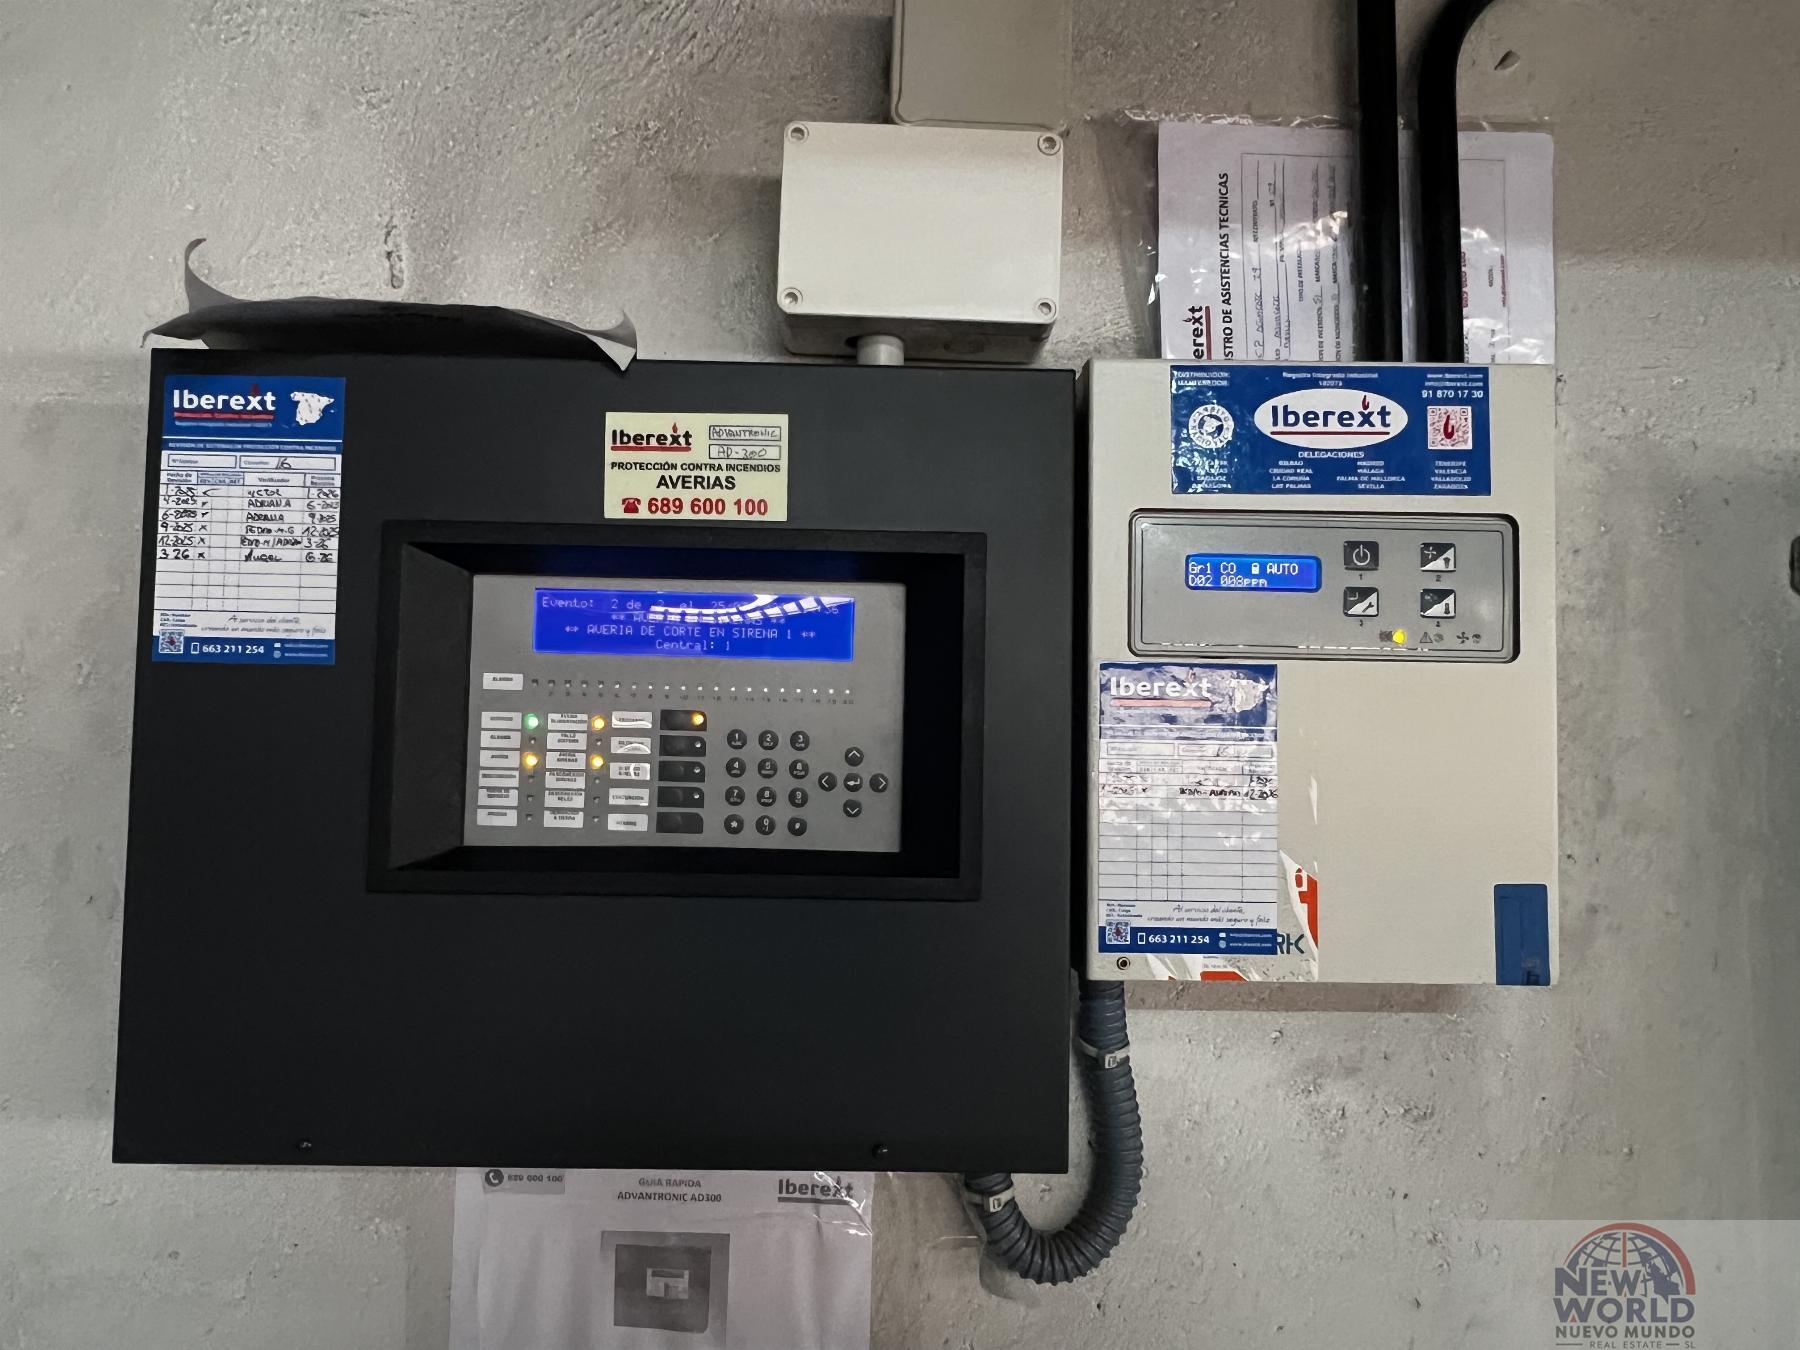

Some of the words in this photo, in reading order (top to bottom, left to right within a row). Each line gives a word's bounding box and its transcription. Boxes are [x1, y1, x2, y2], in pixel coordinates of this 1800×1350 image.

[1218, 172, 1230, 230] TECNICAS
[1219, 233, 1232, 306] ASISTENCIAS
[1222, 308, 1233, 324] DE
[1189, 305, 1205, 360] erext
[173, 389, 276, 410] Iberext
[1421, 390, 1433, 398] 91
[1436, 390, 1455, 398] 870
[1458, 390, 1469, 398] 17
[1471, 390, 1484, 398] 30
[1271, 404, 1391, 428] Iberext
[611, 428, 692, 446] Iberext
[1298, 451, 1365, 459] DELEGACIONES
[611, 461, 678, 471] PROTECCIÓN
[680, 462, 724, 472] CONTRA
[725, 463, 781, 472] INCENDIOS
[656, 475, 737, 490] AVERIAS
[647, 497, 684, 515] 689
[690, 498, 726, 515] 600
[734, 498, 769, 515] 100
[1188, 562, 1212, 574] Gr1
[1220, 562, 1236, 574] CO
[1266, 563, 1299, 575] AUTO
[1188, 575, 1213, 587] D02
[542, 596, 594, 608] Evento:
[611, 599, 618, 609] 2
[626, 600, 642, 610] de
[587, 625, 633, 636] AVERIA
[641, 626, 655, 636] DE
[663, 626, 701, 637] CORTE
[709, 628, 725, 637] EN
[732, 628, 778, 639] SIRENA
[202, 644, 221, 653] 663
[224, 644, 242, 654] 211
[245, 645, 265, 654] 254
[655, 639, 714, 650] Central:
[1110, 676, 1212, 697] Iberext
[1148, 935, 1167, 944] 663
[1170, 935, 1188, 944] 211
[1191, 936, 1210, 944] 254
[778, 1178, 854, 1198] Iberext
[617, 1191, 688, 1201] ADVANTRONIC
[690, 1193, 722, 1202] AD300
